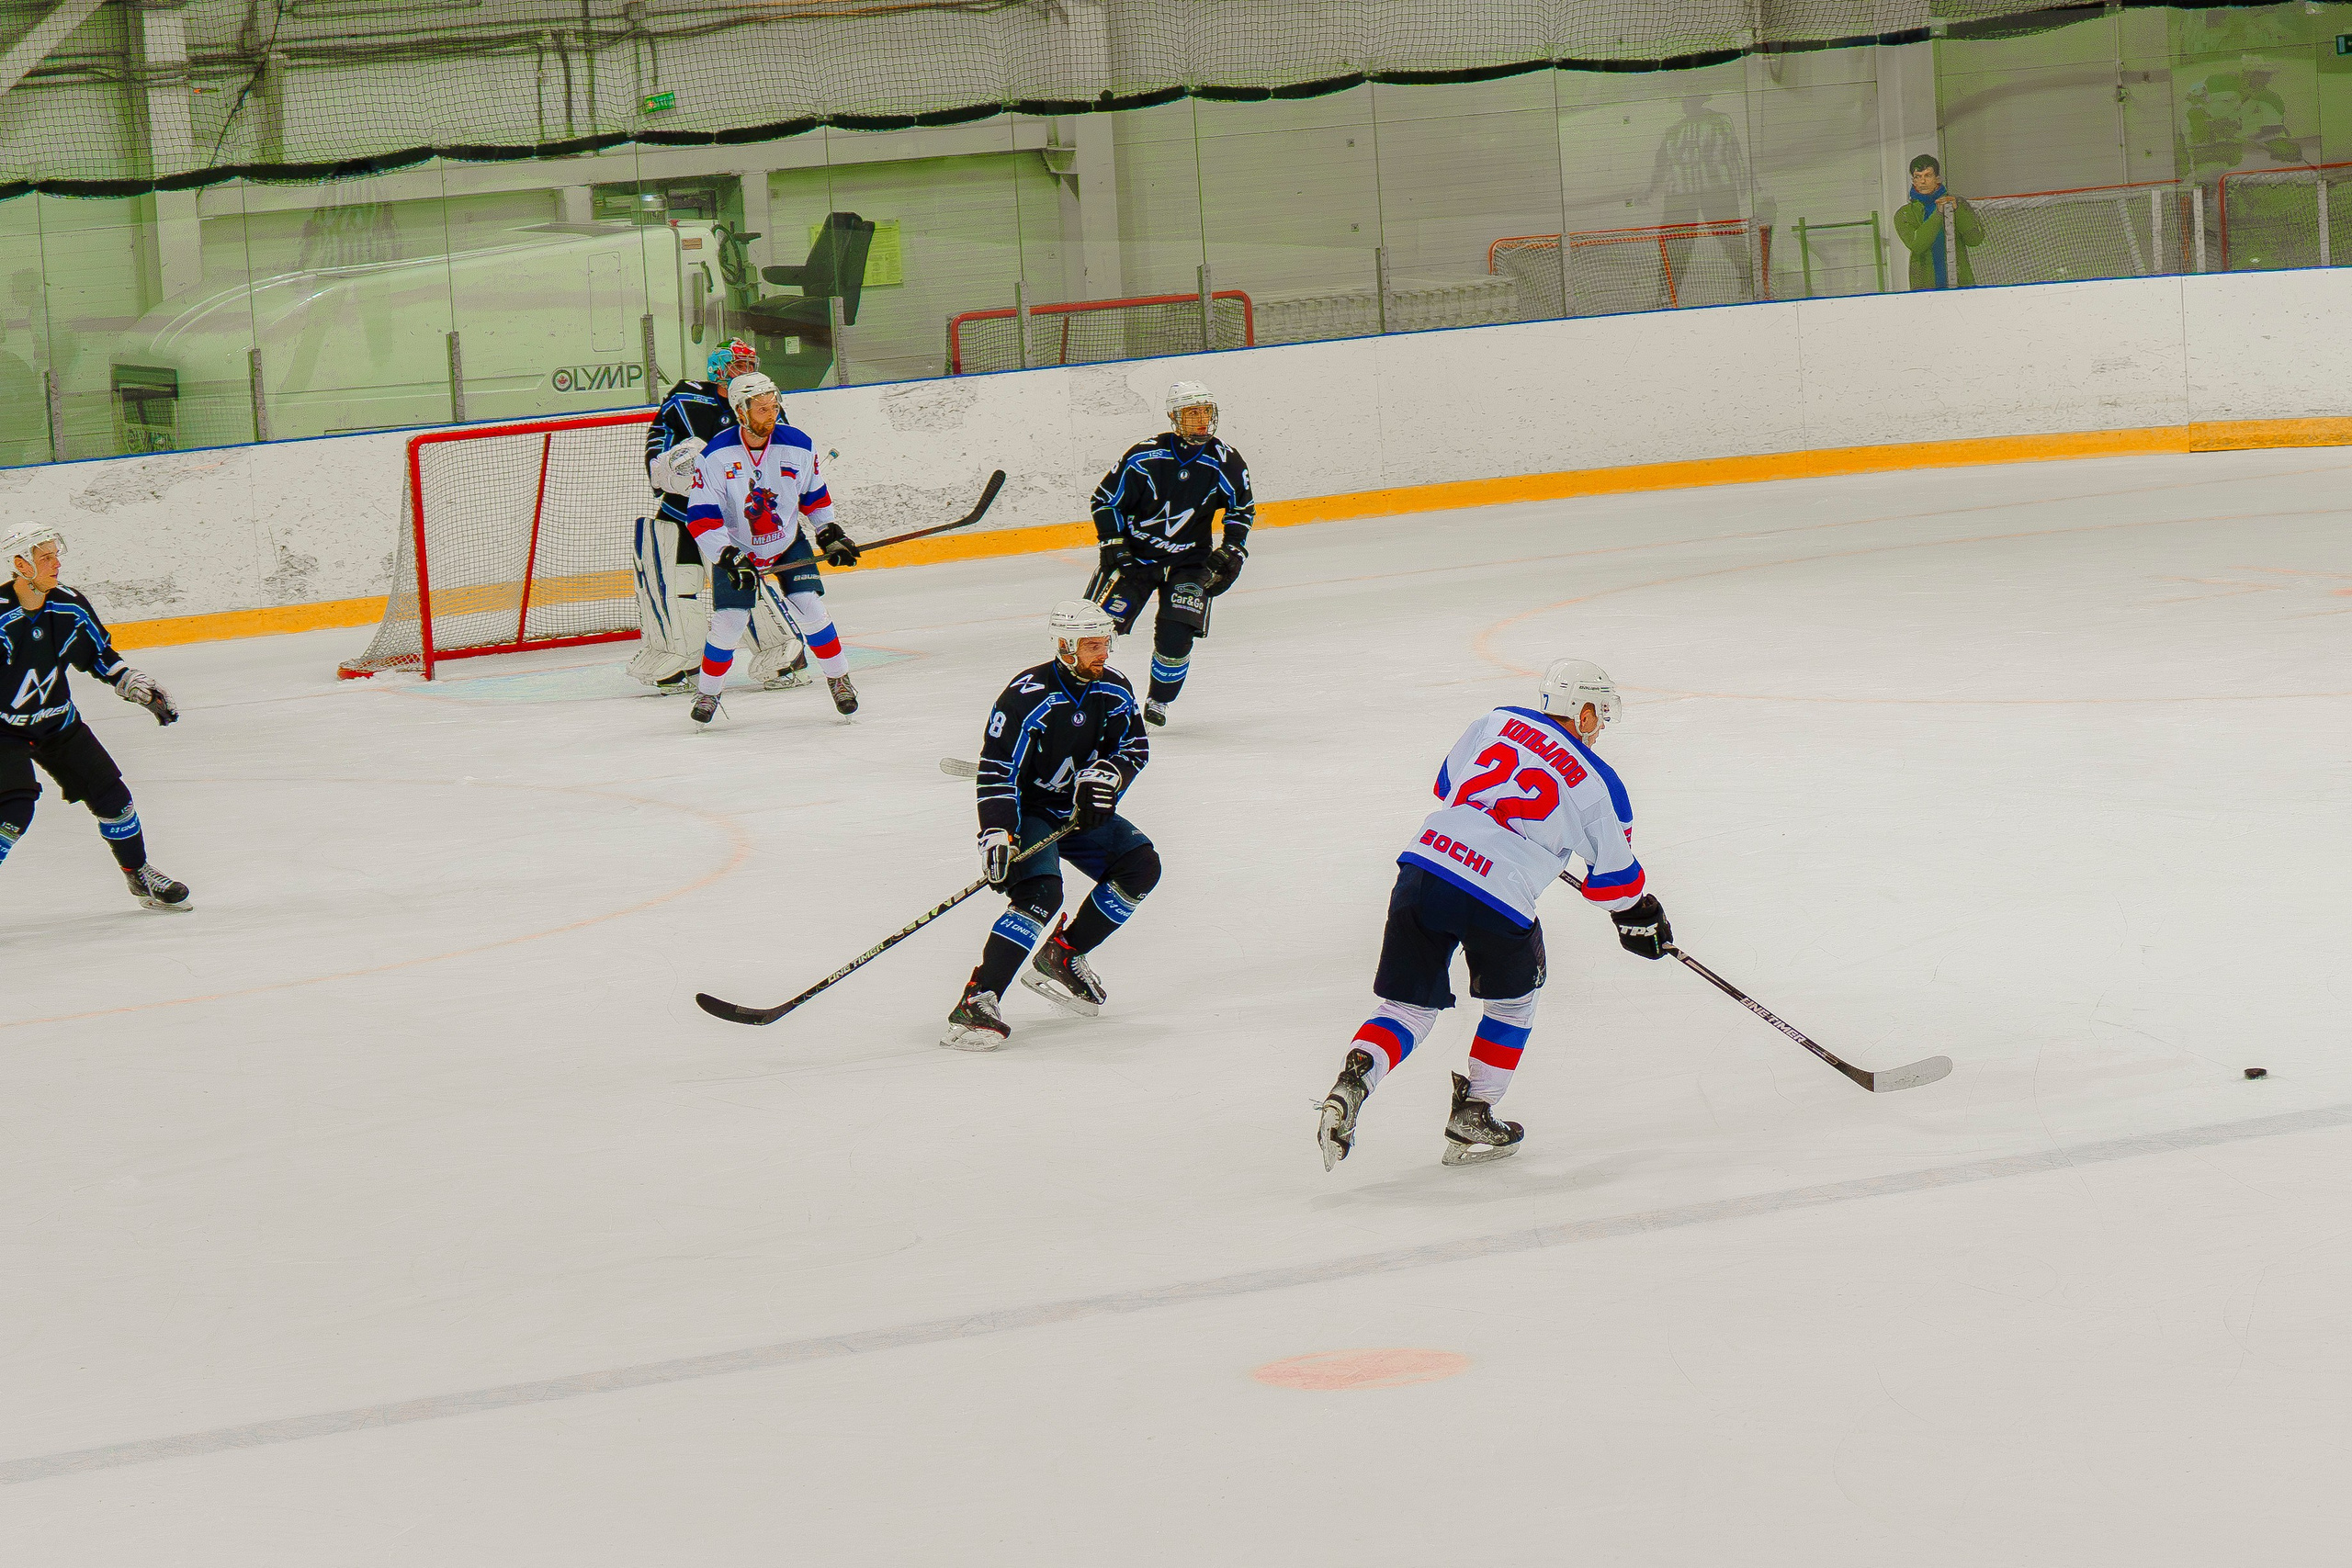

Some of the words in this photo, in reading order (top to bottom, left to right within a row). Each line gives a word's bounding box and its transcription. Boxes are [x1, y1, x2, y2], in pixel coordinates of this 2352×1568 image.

[552, 364, 673, 391] OLYMPA
[753, 532, 783, 545] МЕДВЕ
[1170, 592, 1204, 610] Car&Go
[0, 711, 29, 726] NE
[1498, 717, 1588, 788] КОПЫЛОВ
[1450, 741, 1560, 840] 22
[1419, 829, 1494, 877] SOCHI
[1619, 922, 1658, 937] TPS
